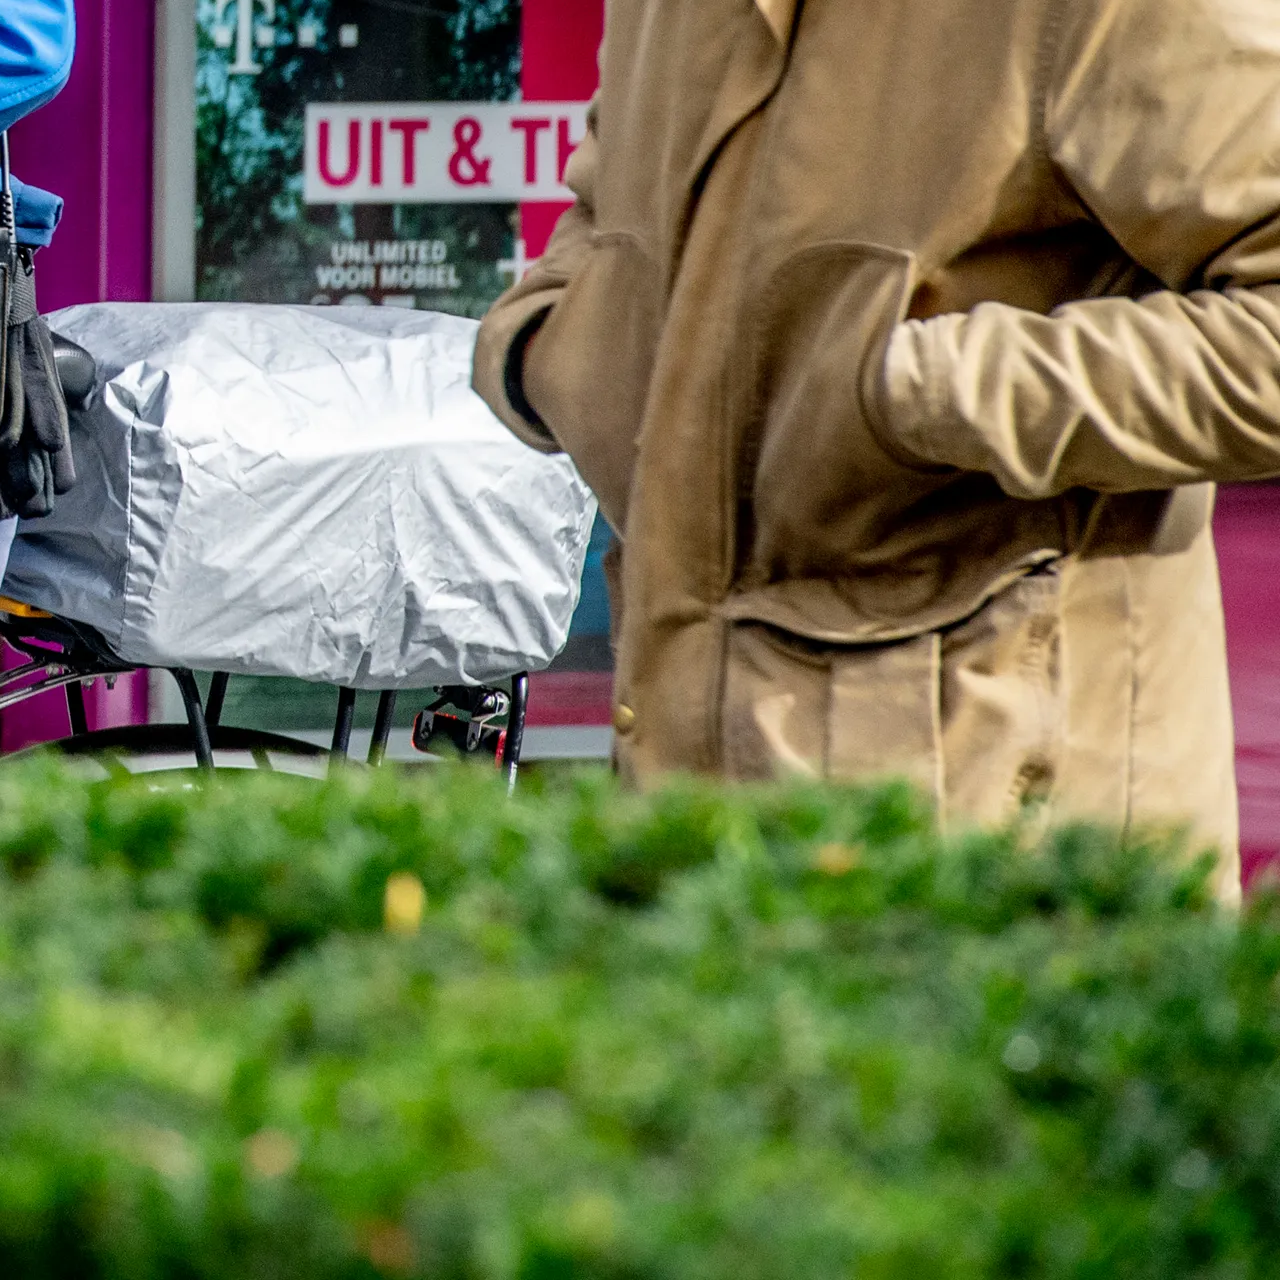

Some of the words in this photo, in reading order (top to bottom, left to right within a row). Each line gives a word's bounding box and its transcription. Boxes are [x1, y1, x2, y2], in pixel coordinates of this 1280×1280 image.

[317, 117, 429, 188] UIT
[447, 116, 492, 188] &
[330, 240, 447, 265] UNLIMITED
[315, 265, 376, 290] VOOR
[379, 265, 461, 290] MOBIEL
